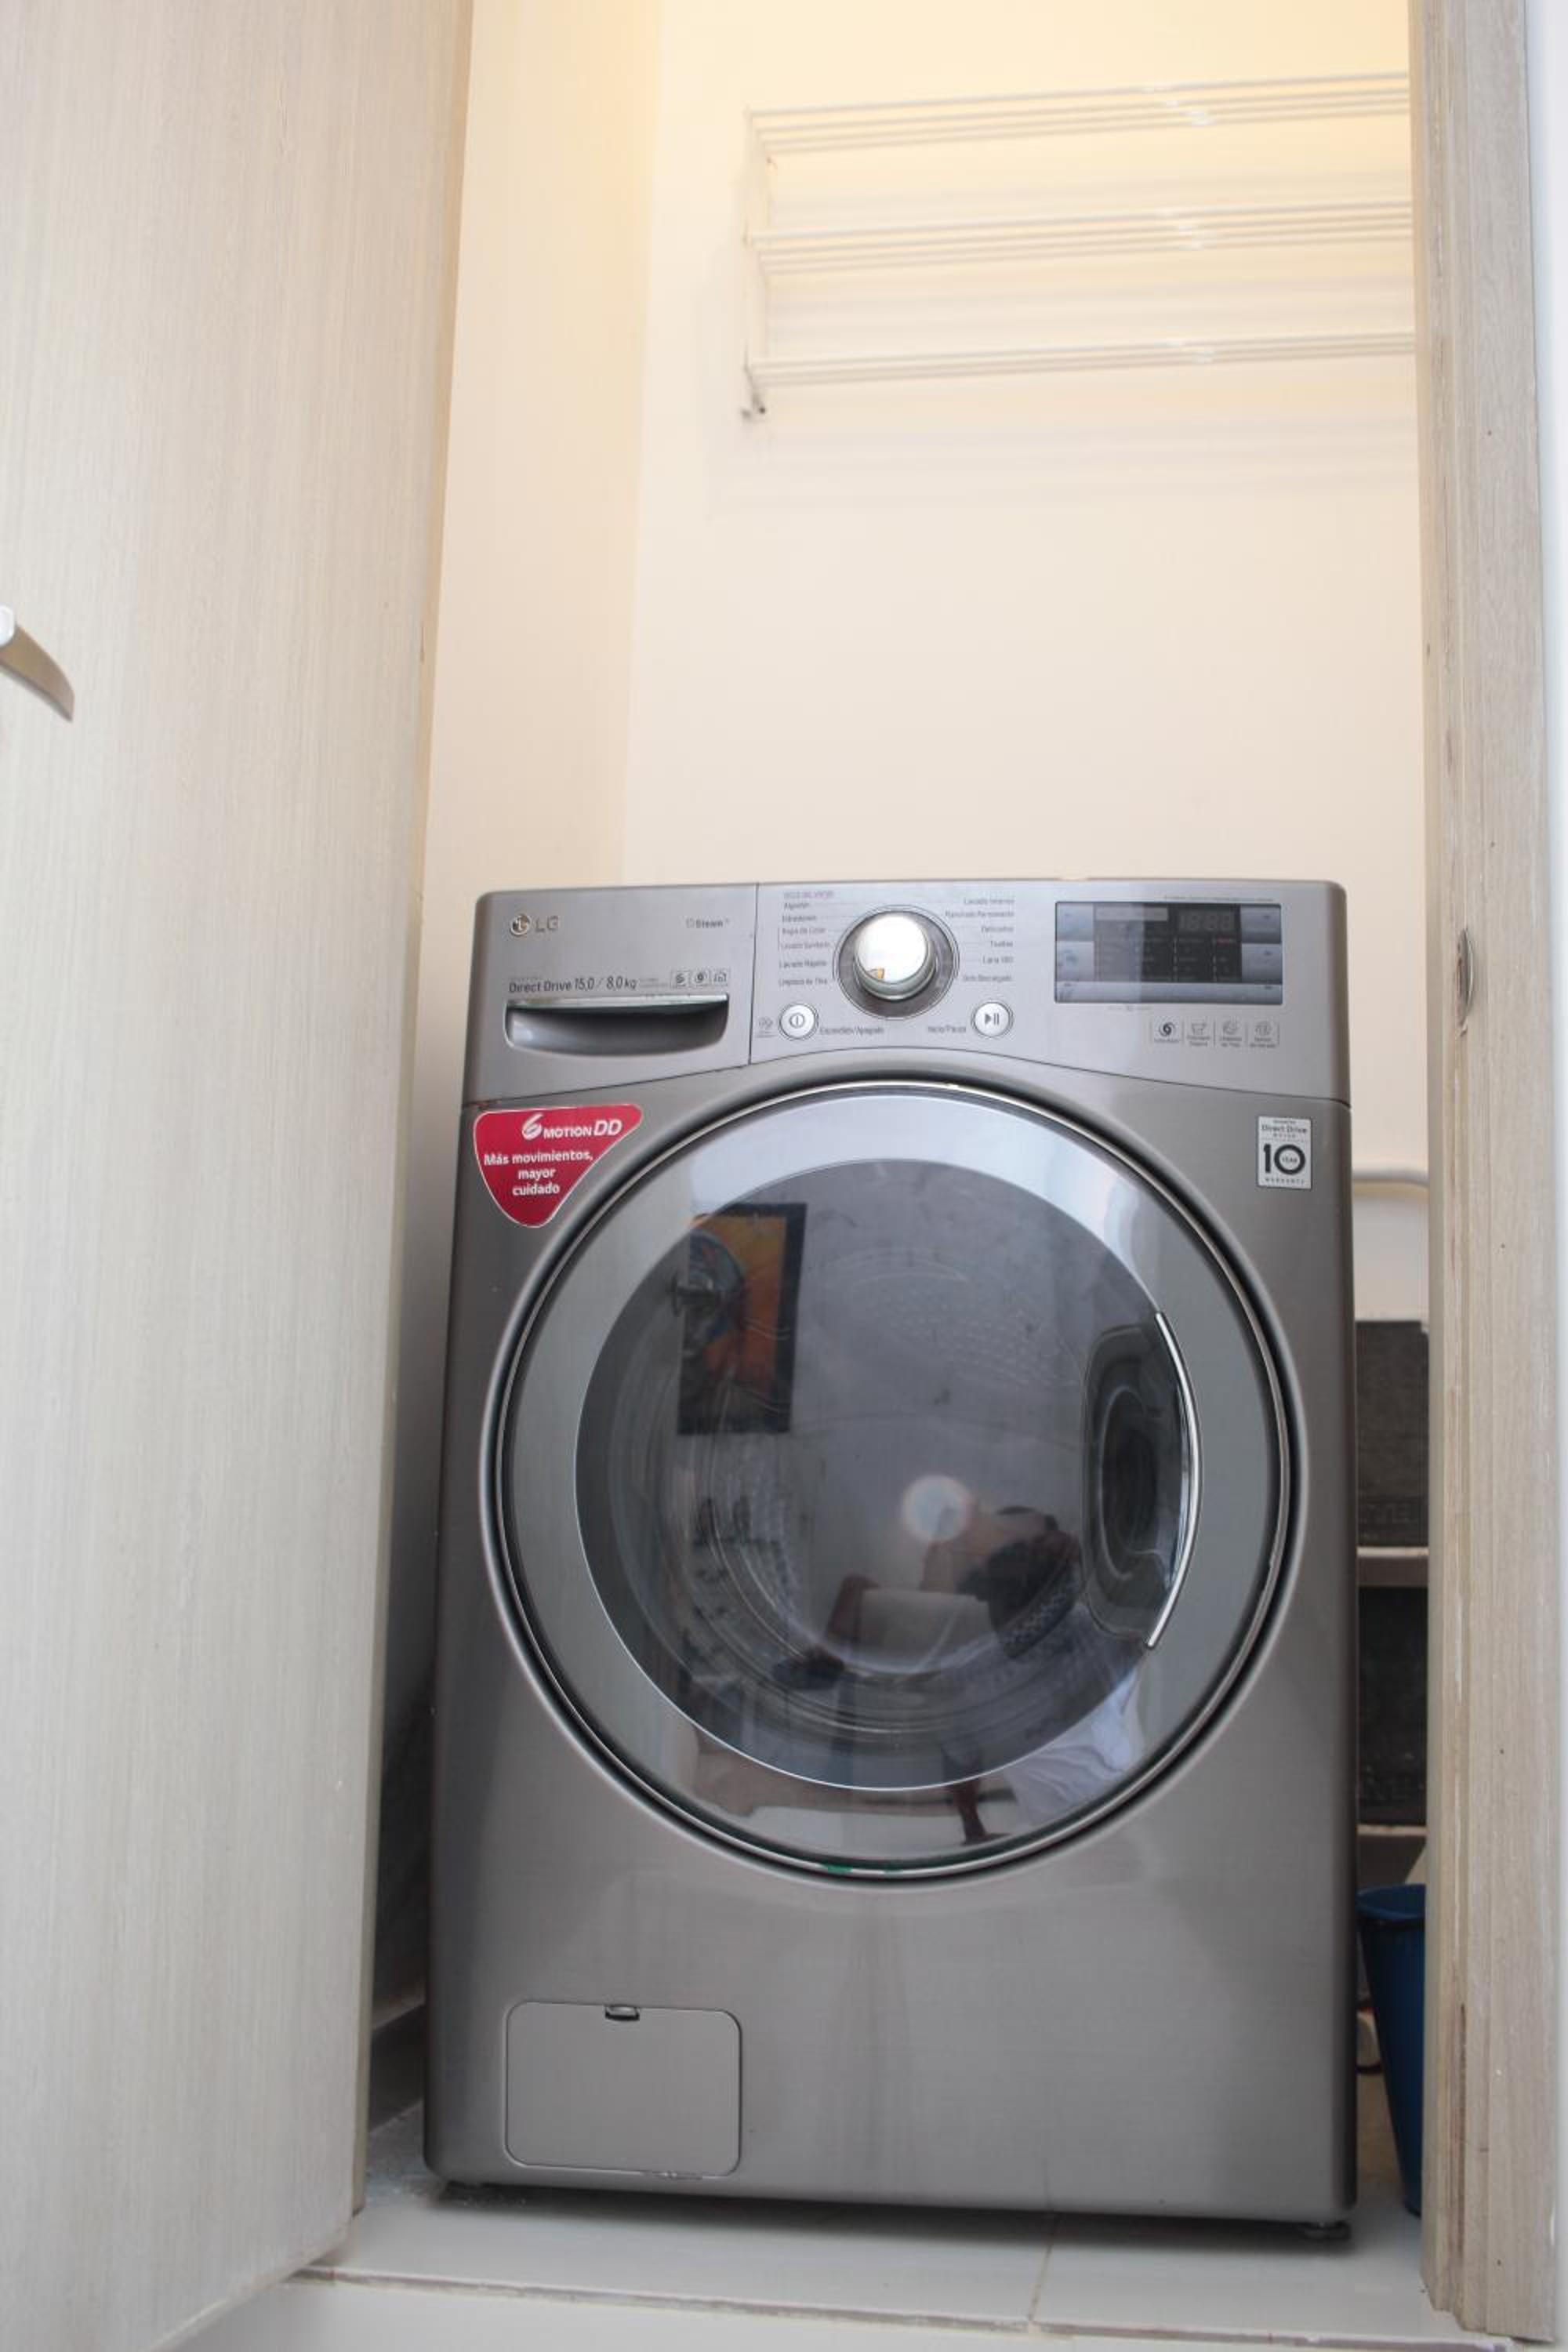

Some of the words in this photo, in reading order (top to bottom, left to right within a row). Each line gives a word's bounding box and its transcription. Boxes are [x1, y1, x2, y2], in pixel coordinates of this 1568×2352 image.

[509, 981, 541, 993] Direct
[544, 979, 572, 992] Drive
[522, 1112, 544, 1140] 6
[543, 1127, 593, 1139] MOTION
[593, 1119, 623, 1136] DD
[484, 1152, 510, 1166] Más
[512, 1149, 593, 1164] movimientos,
[1264, 1143, 1306, 1175] 10
[517, 1167, 556, 1181] mayor
[512, 1182, 560, 1196] cuidado
